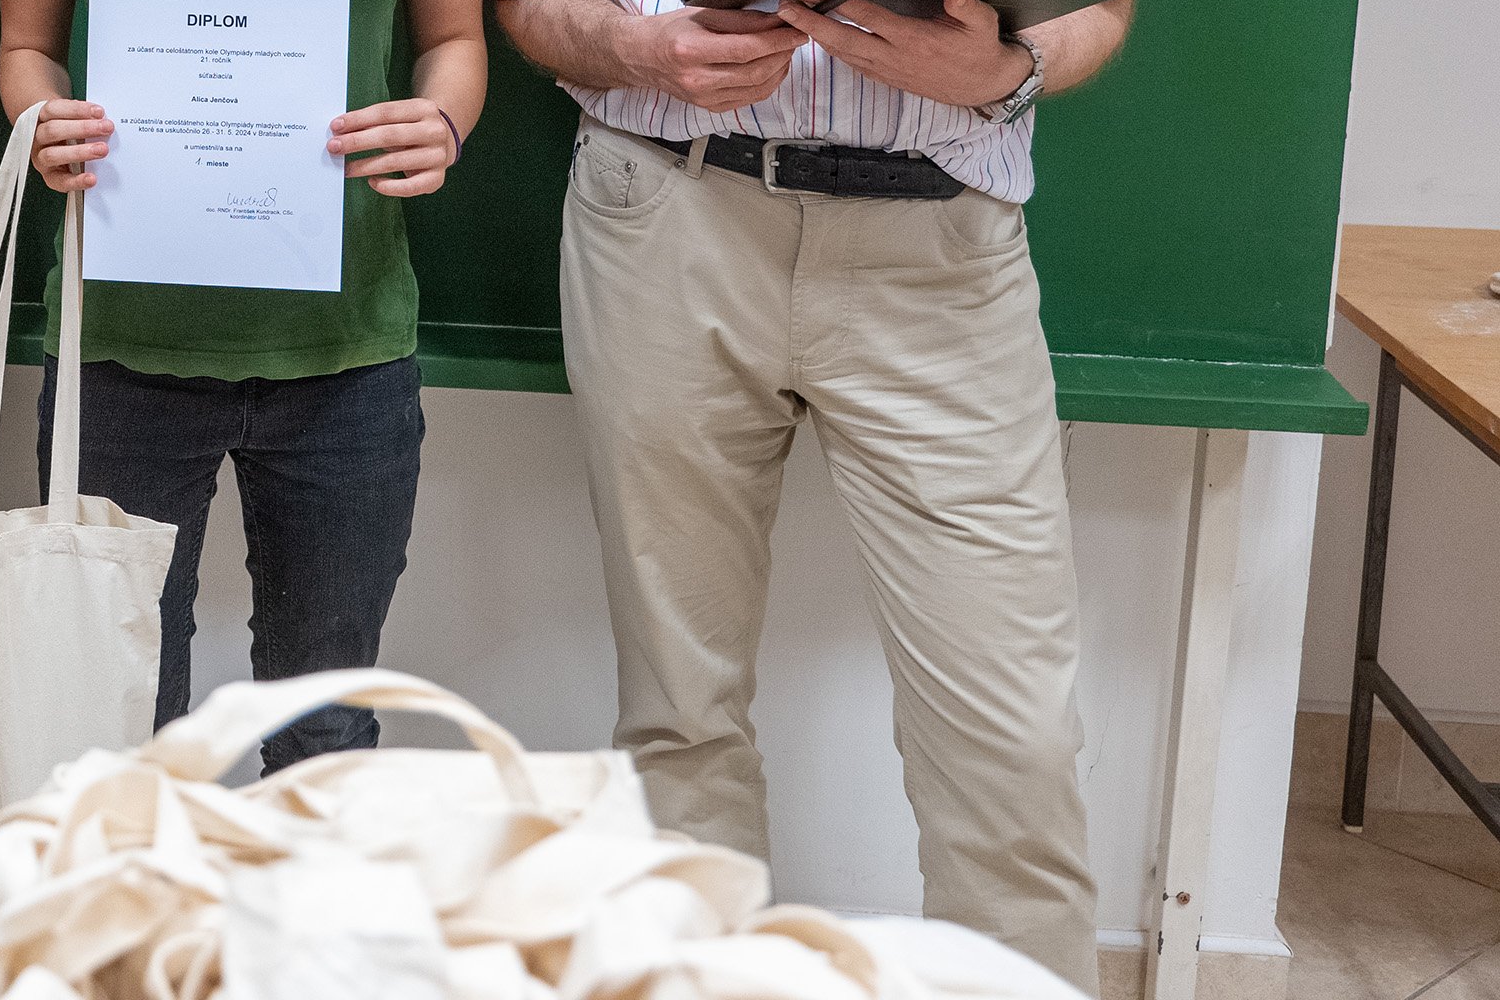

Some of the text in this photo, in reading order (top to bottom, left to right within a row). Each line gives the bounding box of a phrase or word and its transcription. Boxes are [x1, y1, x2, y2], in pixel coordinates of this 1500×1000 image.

[187, 14, 247, 28] DIPLOM
[219, 48, 254, 58] Olympiády
[254, 50, 282, 58] mladých
[191, 95, 239, 104] Alica Jenčová
[220, 120, 254, 130] Olympiády
[255, 121, 282, 130] mladých
[138, 125, 155, 133] ktoré
[164, 127, 201, 135] uskutočnilo
[258, 130, 290, 138] Bratislave
[206, 160, 230, 168] mieste
